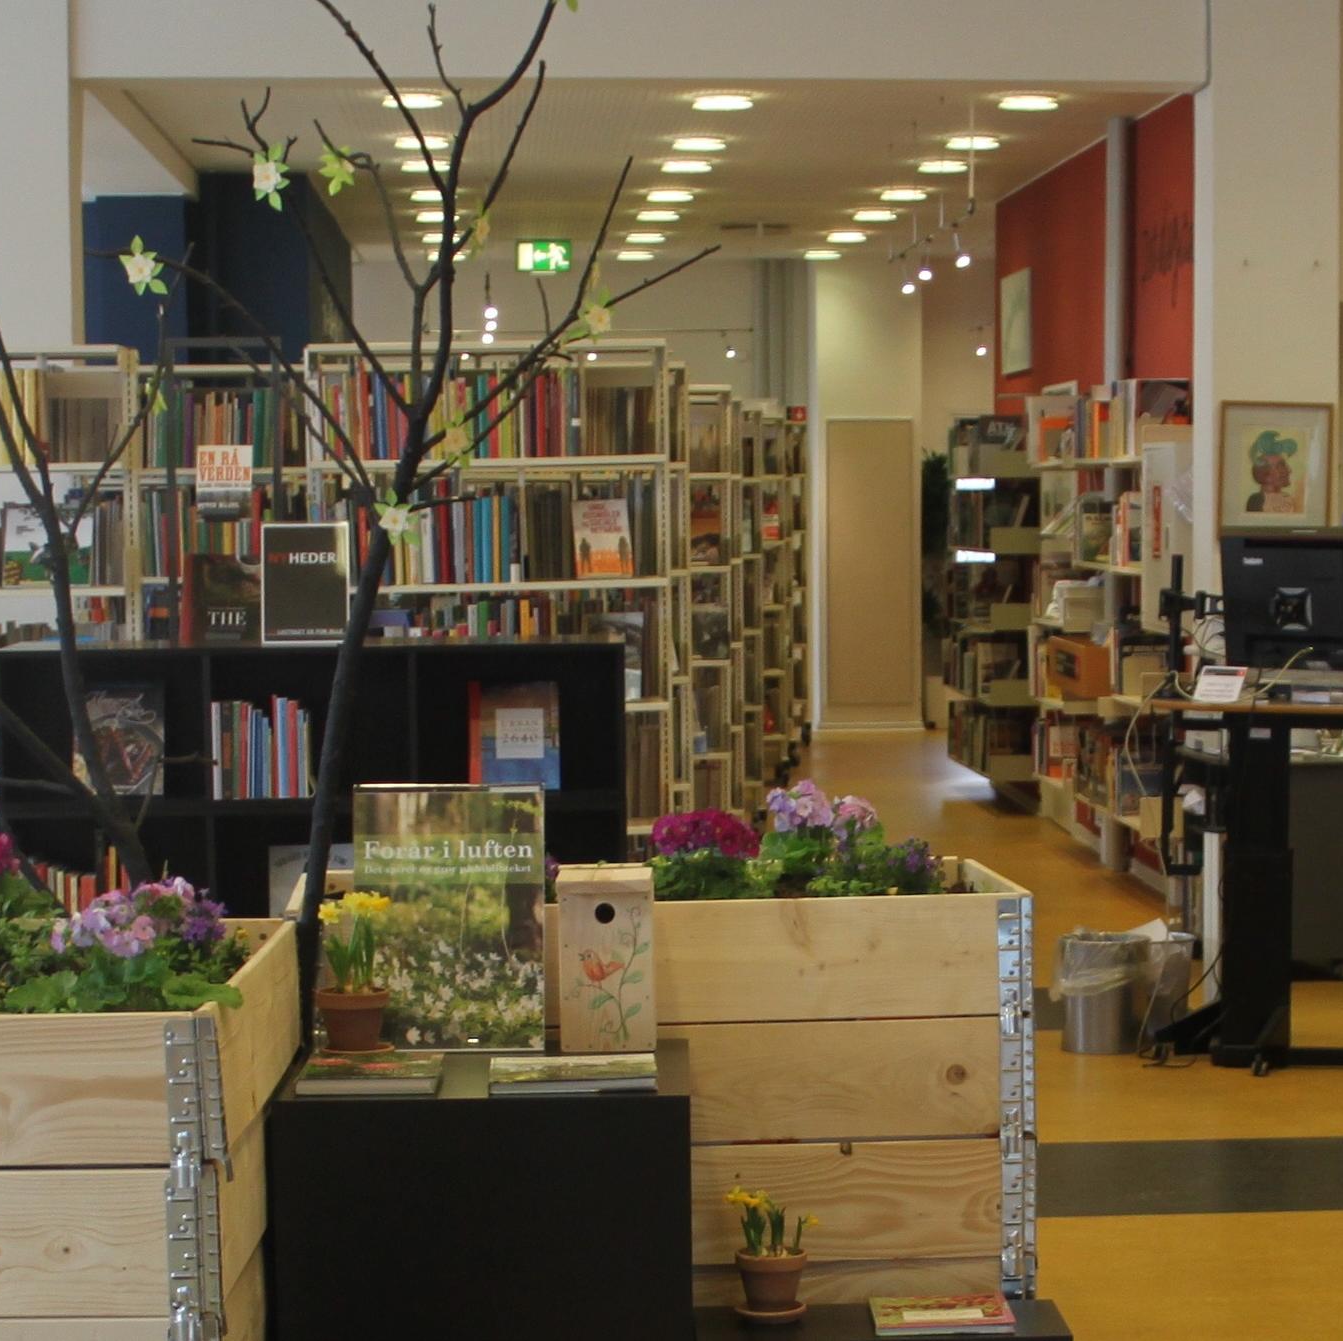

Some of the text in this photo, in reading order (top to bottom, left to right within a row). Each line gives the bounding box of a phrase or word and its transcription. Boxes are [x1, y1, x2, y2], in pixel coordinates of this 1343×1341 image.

[198, 451, 215, 465] EN
[198, 466, 252, 482] VERDEN
[207, 610, 247, 626] THE
[363, 839, 435, 860] Forår
[442, 840, 450, 859] i
[458, 839, 534, 859] luften
